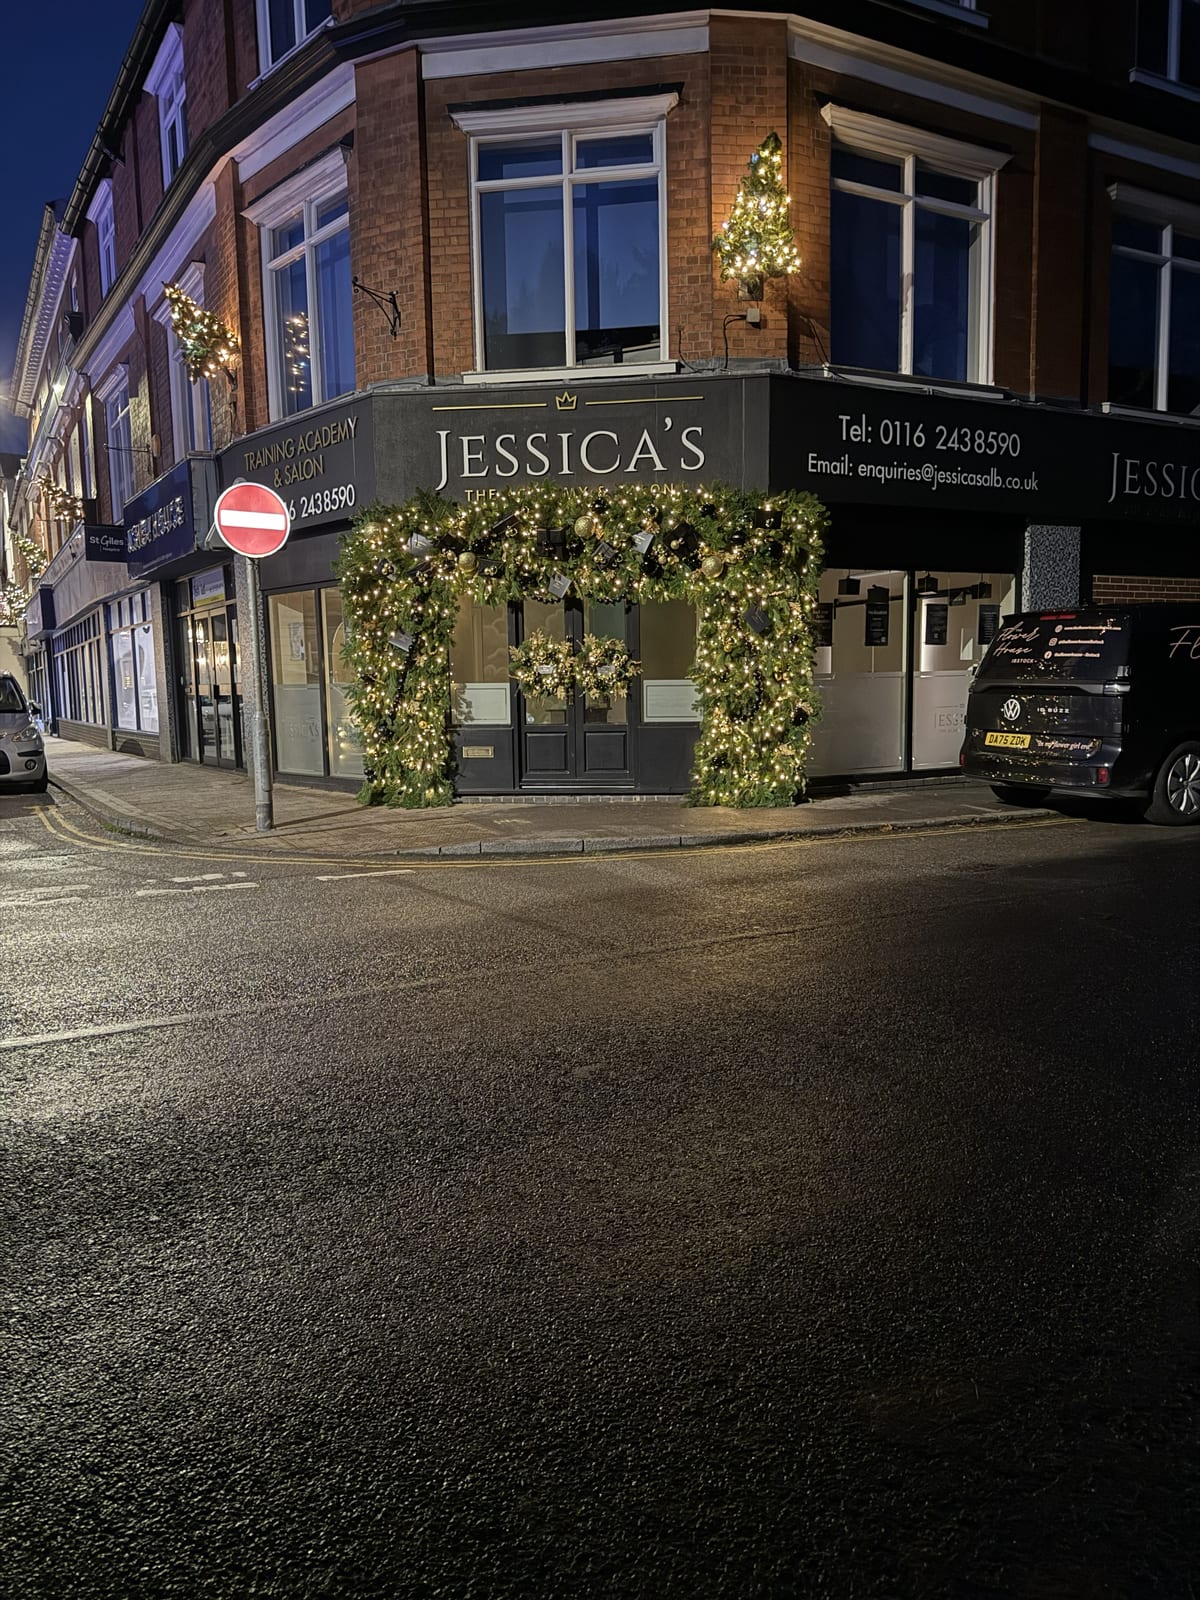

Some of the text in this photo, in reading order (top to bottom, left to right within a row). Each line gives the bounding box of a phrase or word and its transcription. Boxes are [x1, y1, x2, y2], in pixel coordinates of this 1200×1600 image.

[244, 416, 357, 472] TRAINING ACADEMY
[434, 416, 706, 491] JESSICA'S
[838, 414, 1021, 457] Tel: 0116 2438590
[273, 454, 324, 488] & SALON
[808, 453, 1039, 491] Email: enquiries@jessicasalb.co.uk
[300, 484, 355, 518] 2438590
[89, 535, 124, 547] St Giles
